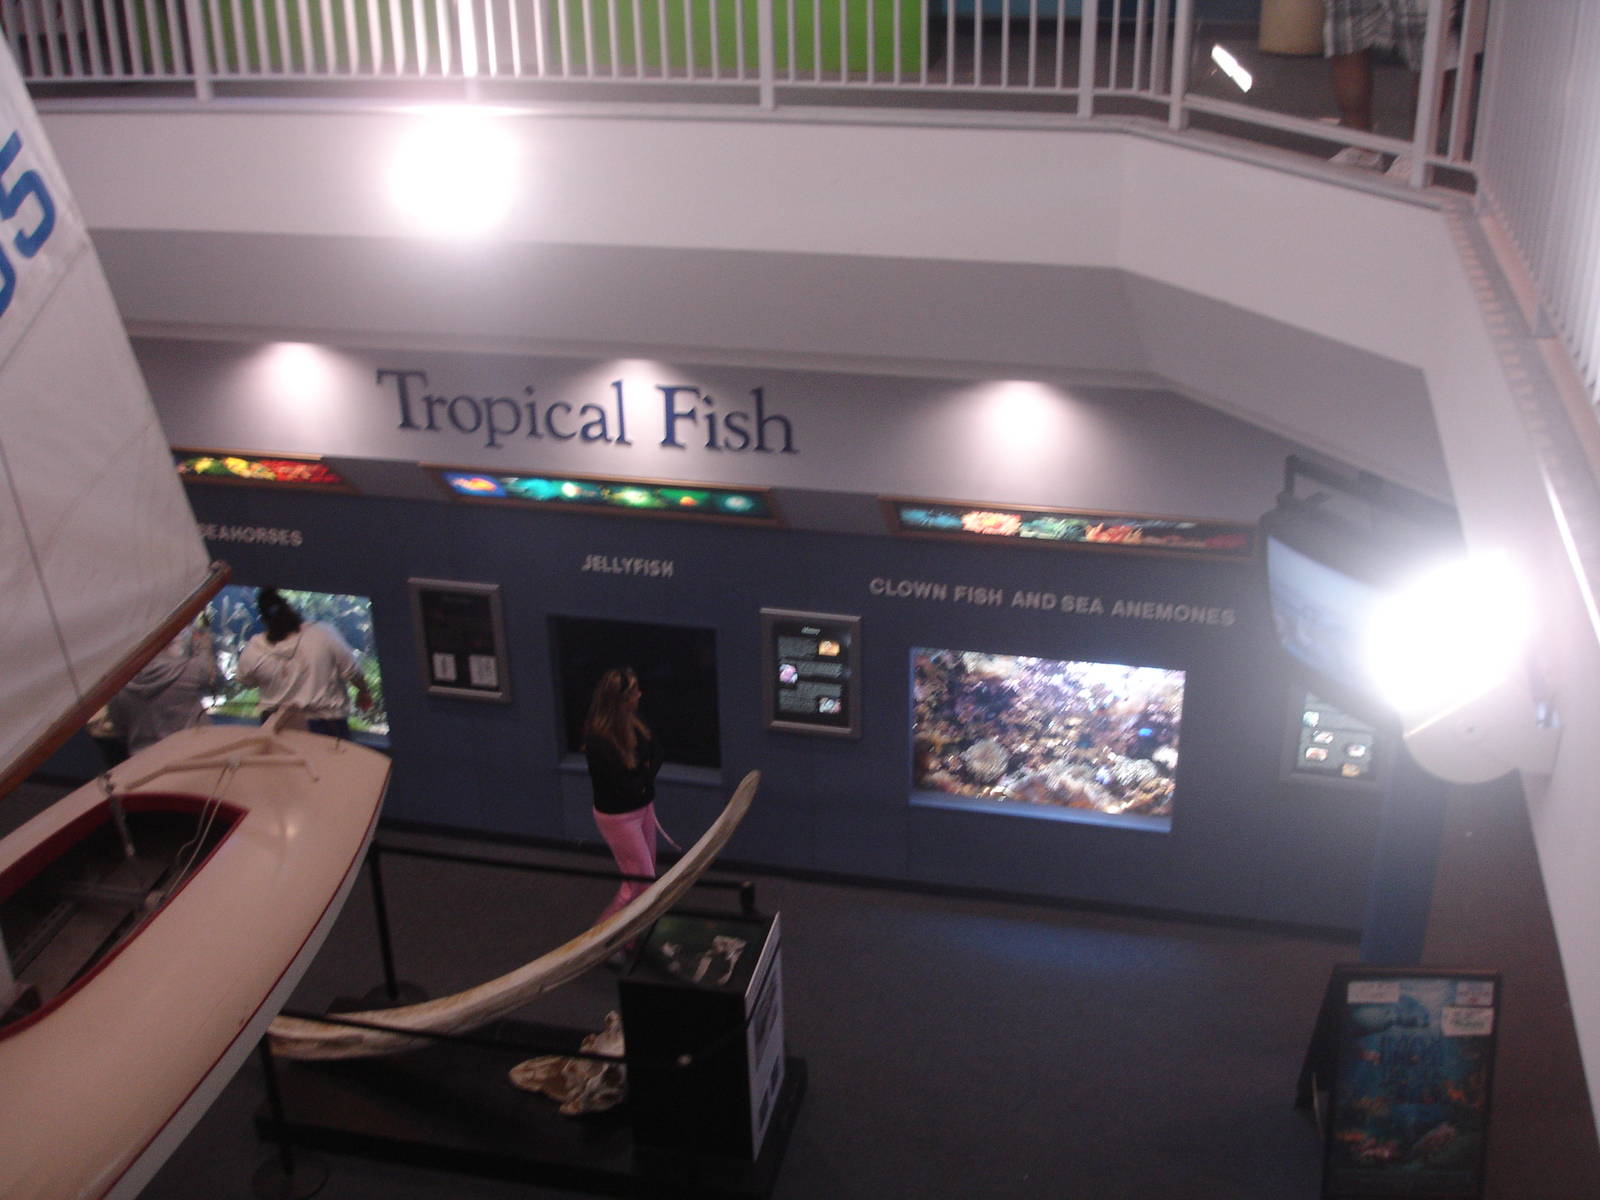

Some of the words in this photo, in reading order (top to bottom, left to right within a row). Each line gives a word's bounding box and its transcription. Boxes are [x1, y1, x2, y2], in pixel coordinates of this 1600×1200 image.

[376, 369, 632, 448] Tropical
[656, 385, 799, 455] Fish
[582, 554, 674, 578] JELLYFISH
[869, 578, 948, 600] CLOWN
[953, 585, 1003, 606] FISH
[1011, 590, 1057, 610] AND
[1061, 595, 1105, 614] SEA
[1112, 600, 1237, 627] ANEMONES
